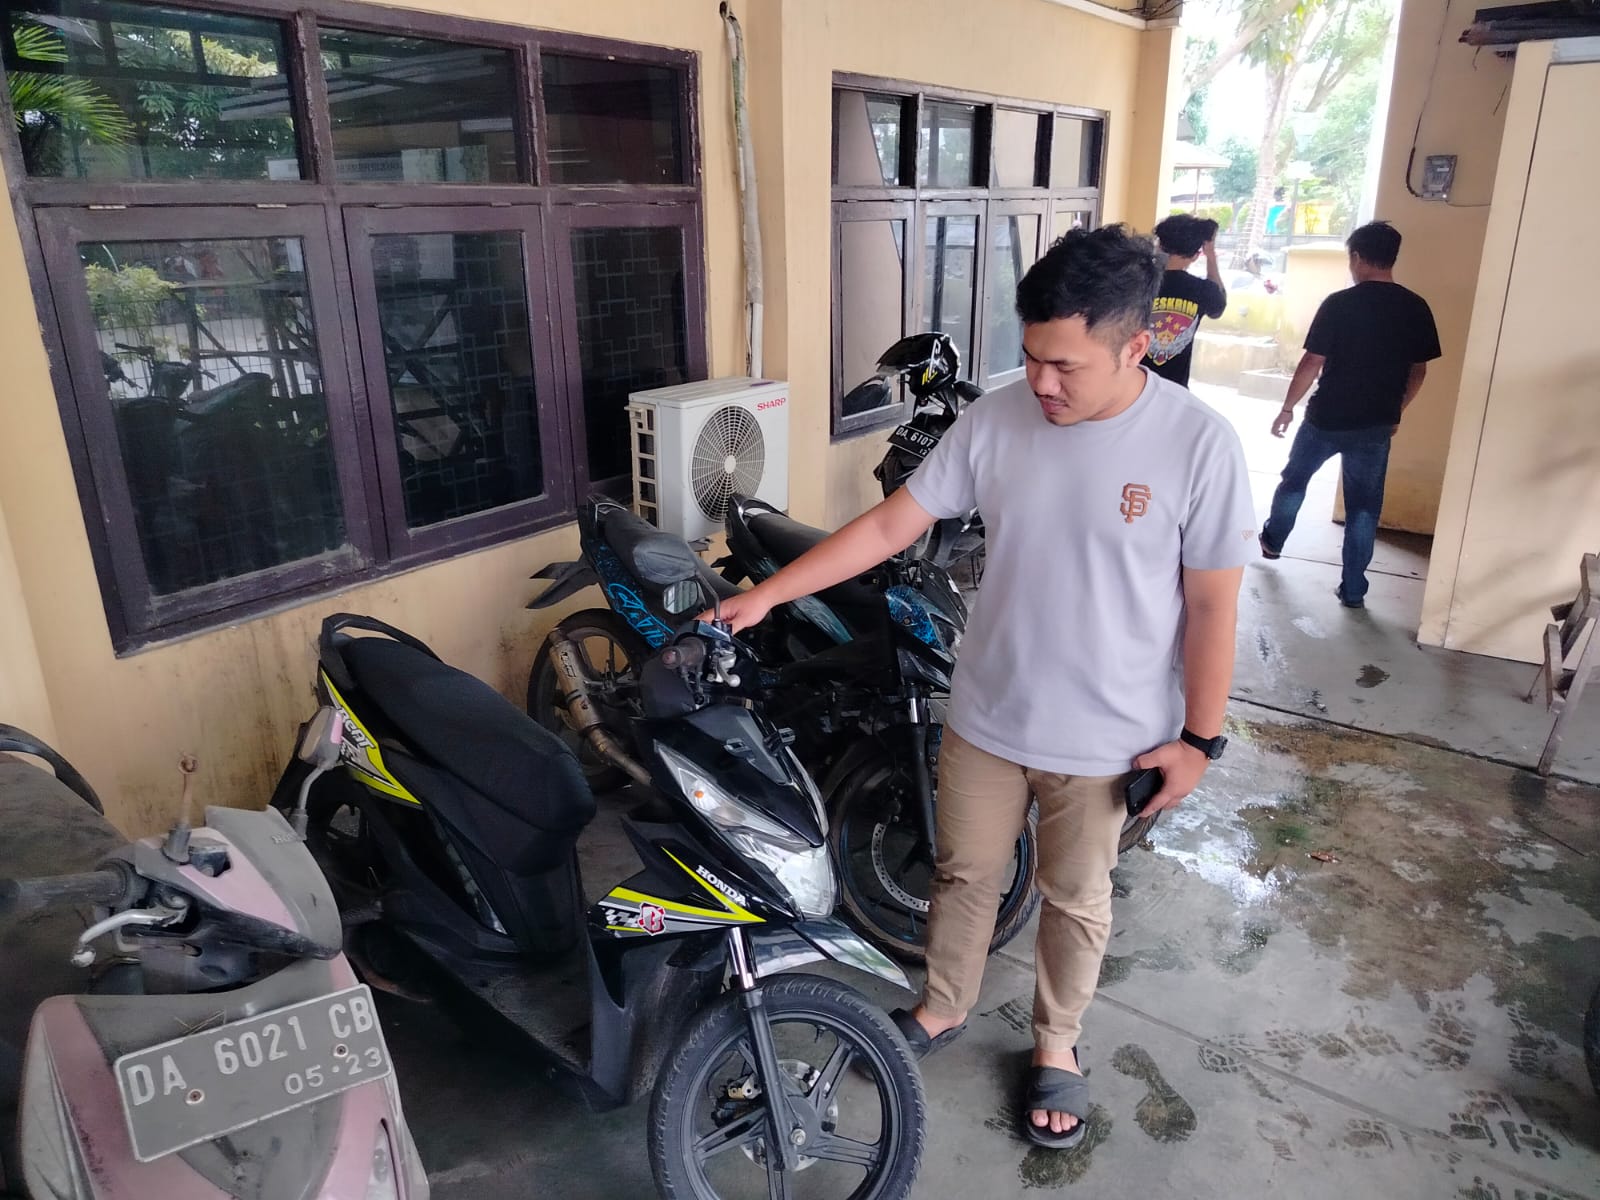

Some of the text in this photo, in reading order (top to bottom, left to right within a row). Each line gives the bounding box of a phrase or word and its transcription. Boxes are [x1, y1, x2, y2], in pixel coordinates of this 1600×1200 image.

[1152, 296, 1198, 317] ESKRIM
[757, 397, 786, 411] SHARP
[895, 427, 935, 448] DA 6107
[1119, 483, 1152, 524] SF
[695, 865, 747, 907] HONDA
[125, 996, 374, 1106] DA 6021 CB
